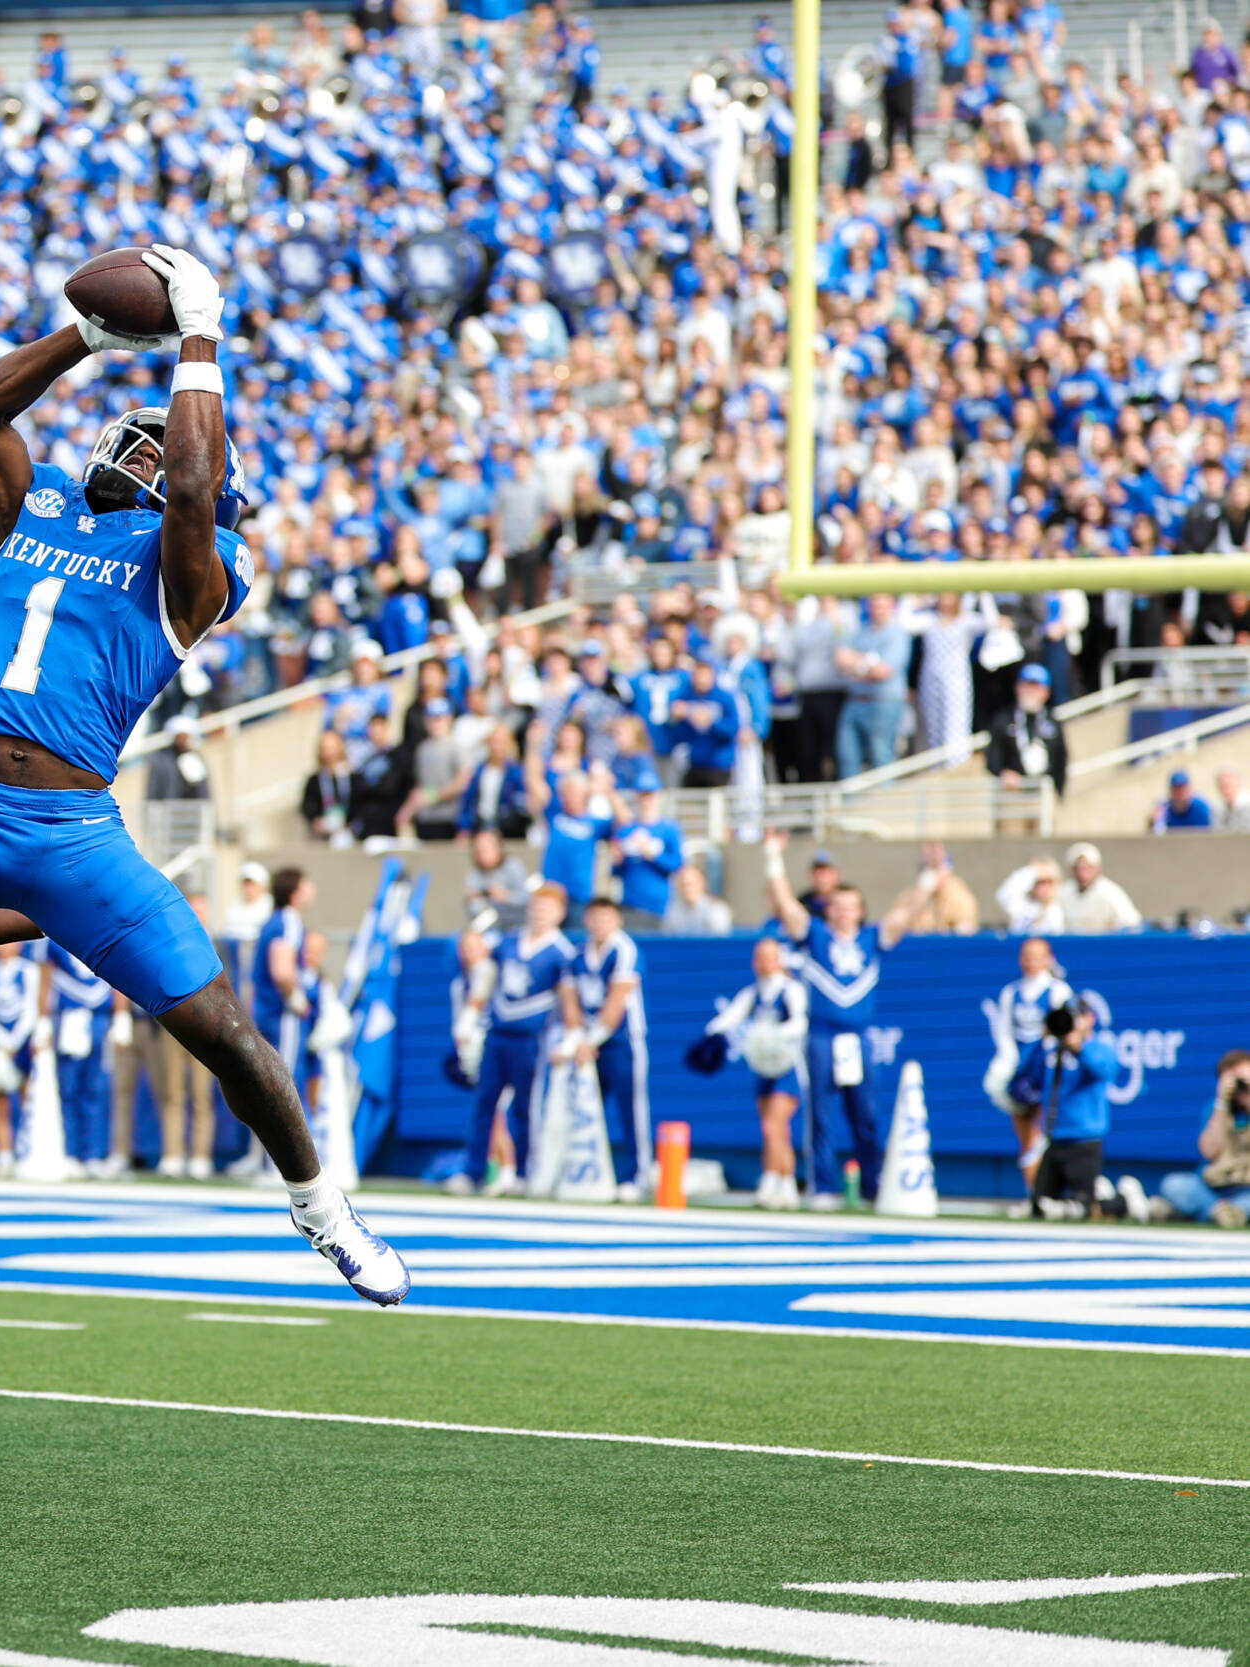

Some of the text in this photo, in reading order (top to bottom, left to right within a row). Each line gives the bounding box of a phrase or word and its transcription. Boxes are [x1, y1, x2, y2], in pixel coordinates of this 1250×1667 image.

[36, 490, 65, 511] SEC
[3, 532, 141, 591] KENTUCKY
[0, 576, 66, 695] 1
